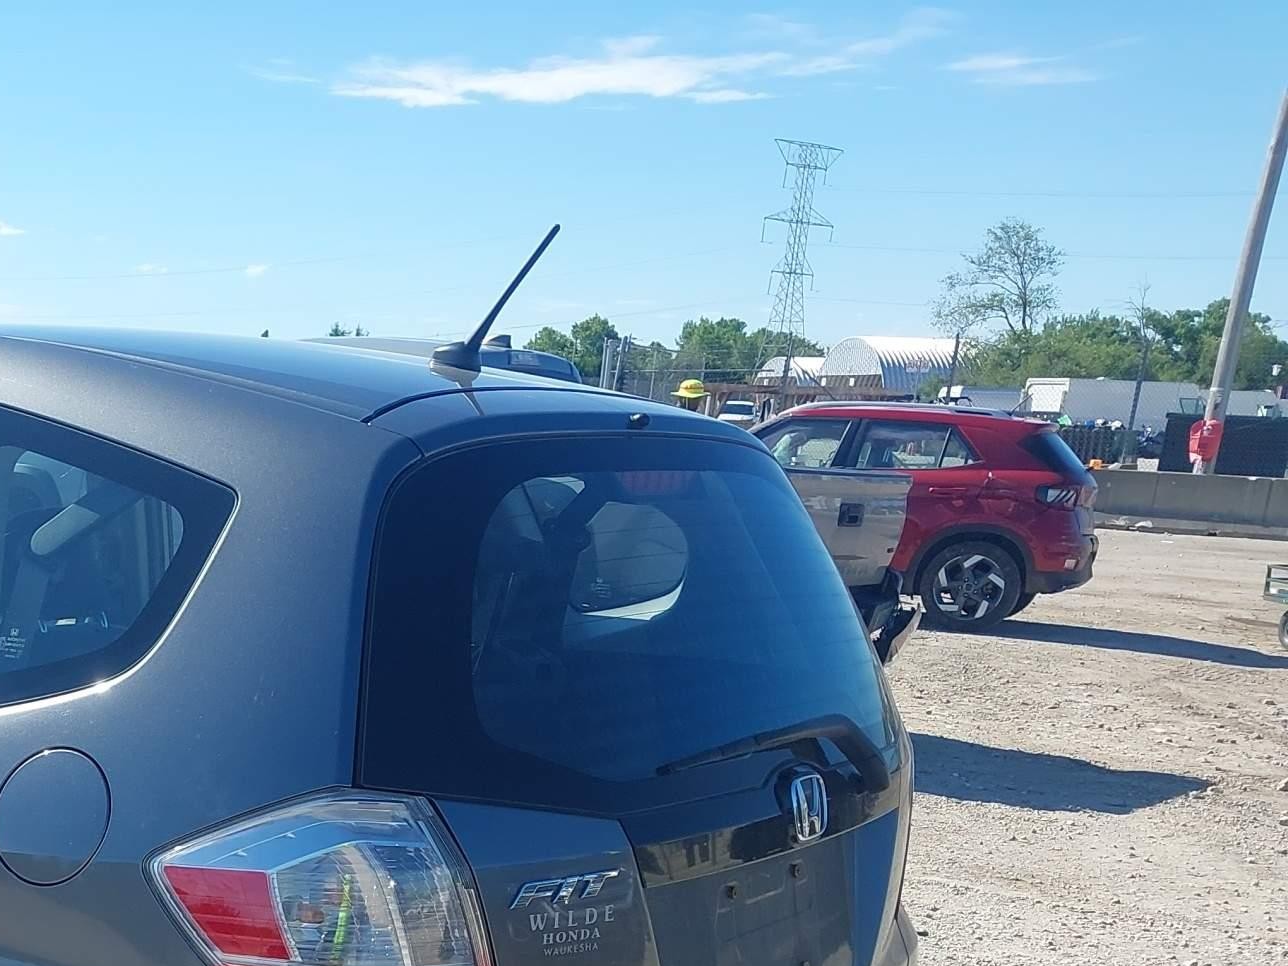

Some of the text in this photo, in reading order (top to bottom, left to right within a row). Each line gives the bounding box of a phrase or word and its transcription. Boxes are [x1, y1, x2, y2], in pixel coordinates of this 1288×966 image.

[509, 866, 625, 910] FIT
[529, 904, 616, 932] WILDE
[542, 927, 601, 946] HONDA
[543, 942, 599, 957] WAUKESHA
